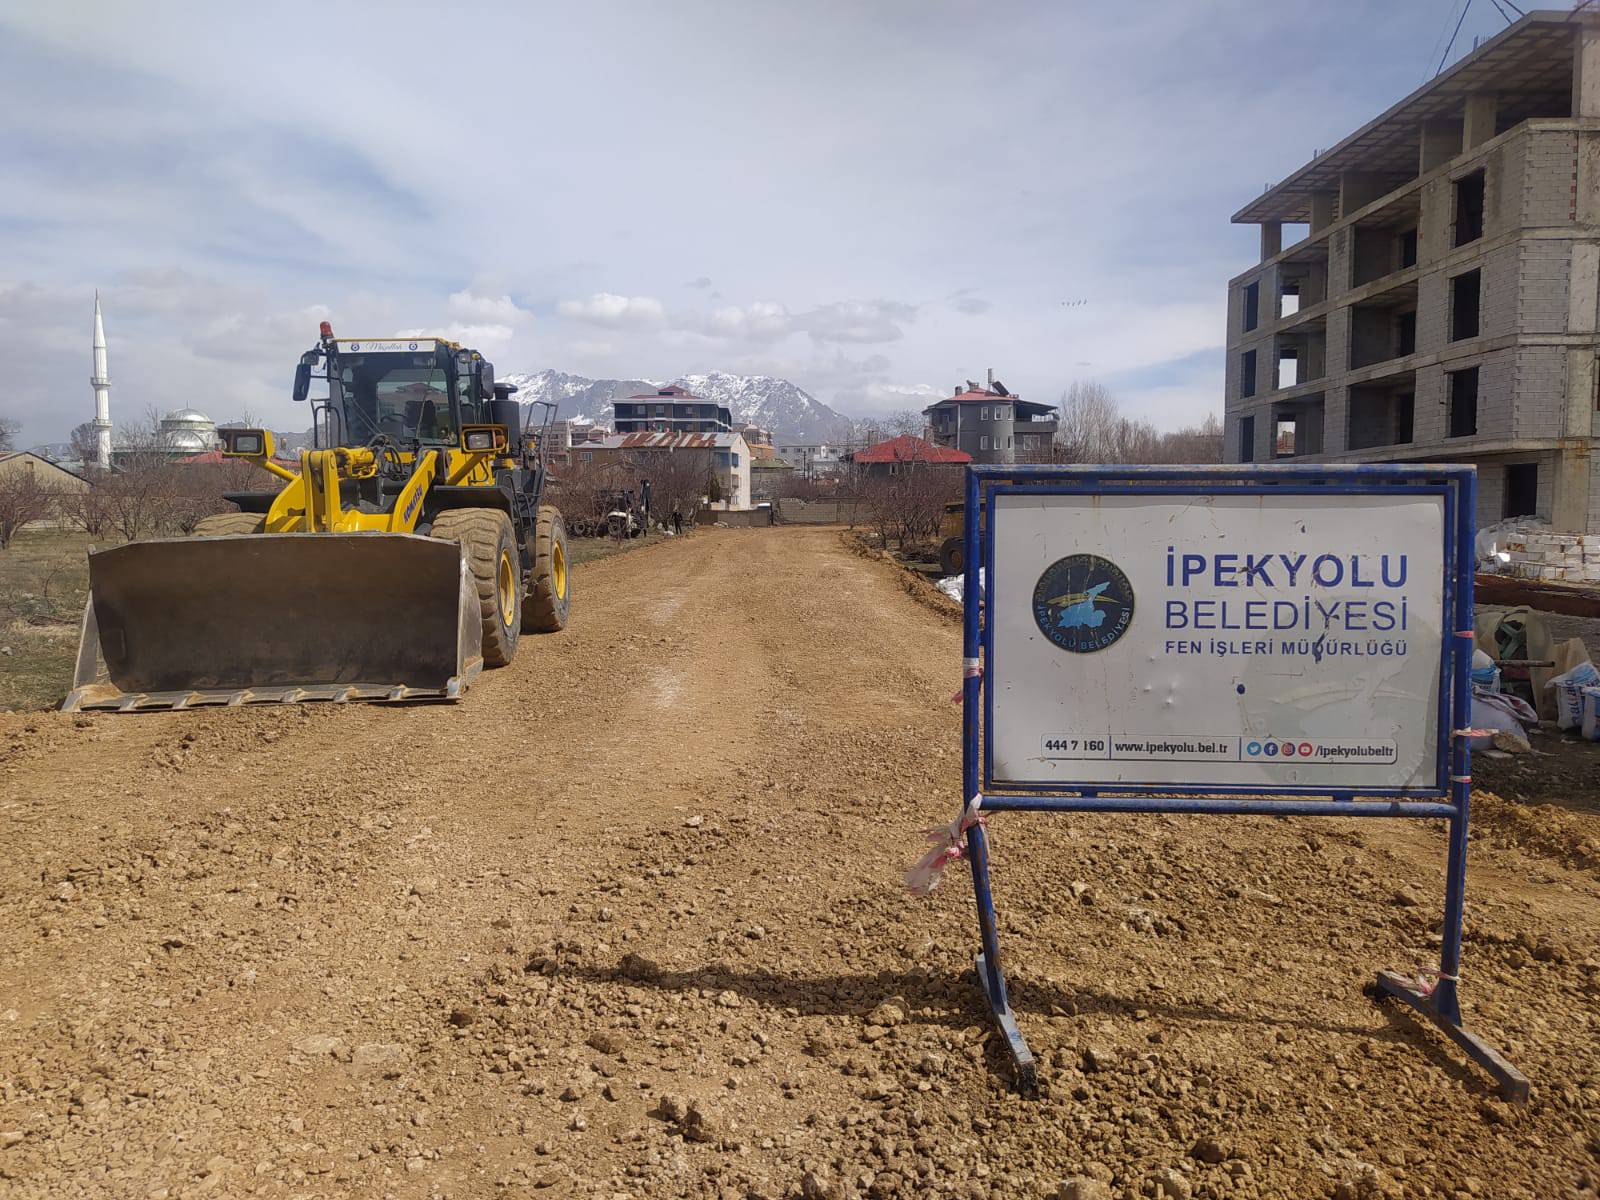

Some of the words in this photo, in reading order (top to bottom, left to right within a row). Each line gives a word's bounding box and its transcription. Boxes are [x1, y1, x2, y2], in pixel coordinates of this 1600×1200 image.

[1167, 546, 1407, 588] İPEKYOLU
[1166, 595, 1407, 631] BELEDİYESİ
[1165, 640, 1202, 654] FEN
[1210, 638, 1273, 657] İŞLERİ
[1045, 739, 1068, 751] 444
[1071, 740, 1078, 750] 7
[1083, 740, 1105, 751] 160
[1114, 741, 1228, 755] www.ipekyolu.bel.tr
[1314, 745, 1394, 758] /ipekyolubeltr
